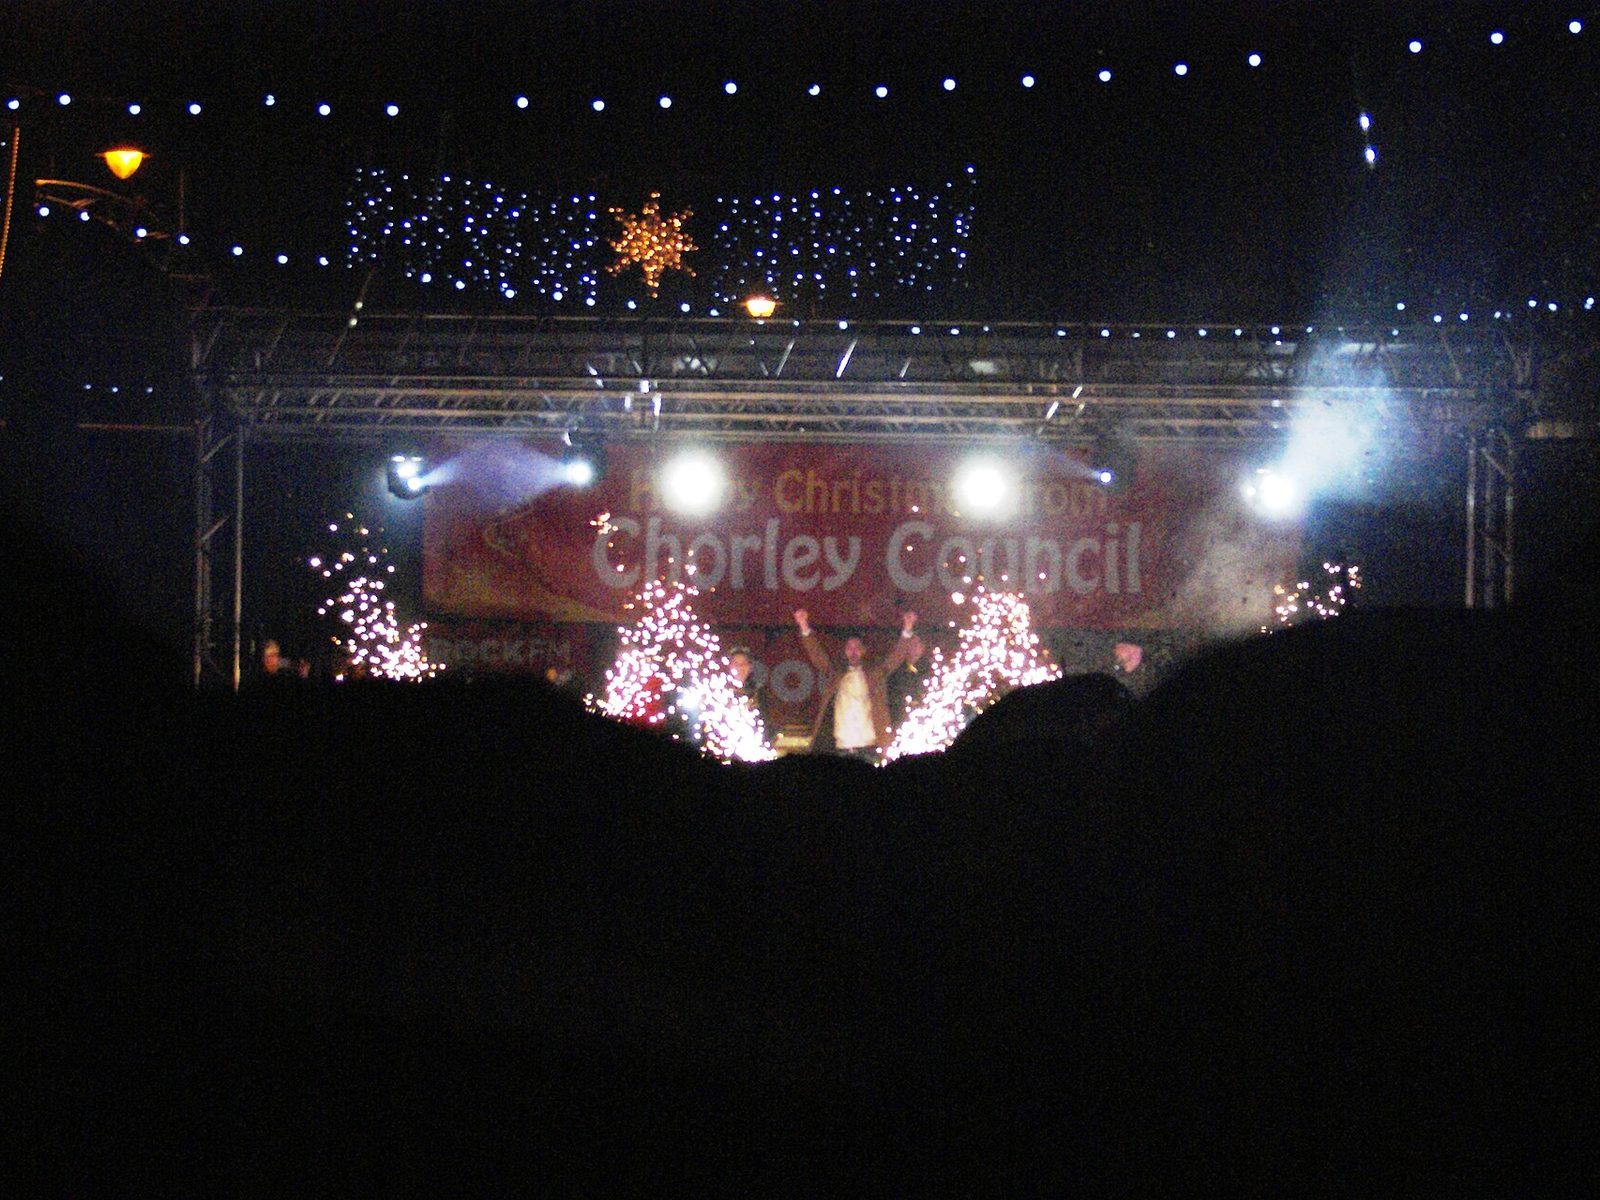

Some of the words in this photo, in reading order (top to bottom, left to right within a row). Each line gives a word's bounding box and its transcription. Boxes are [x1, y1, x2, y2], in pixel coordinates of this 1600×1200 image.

[772, 467, 978, 515] Christm
[591, 516, 861, 592] Chorley
[887, 520, 1142, 594] Council
